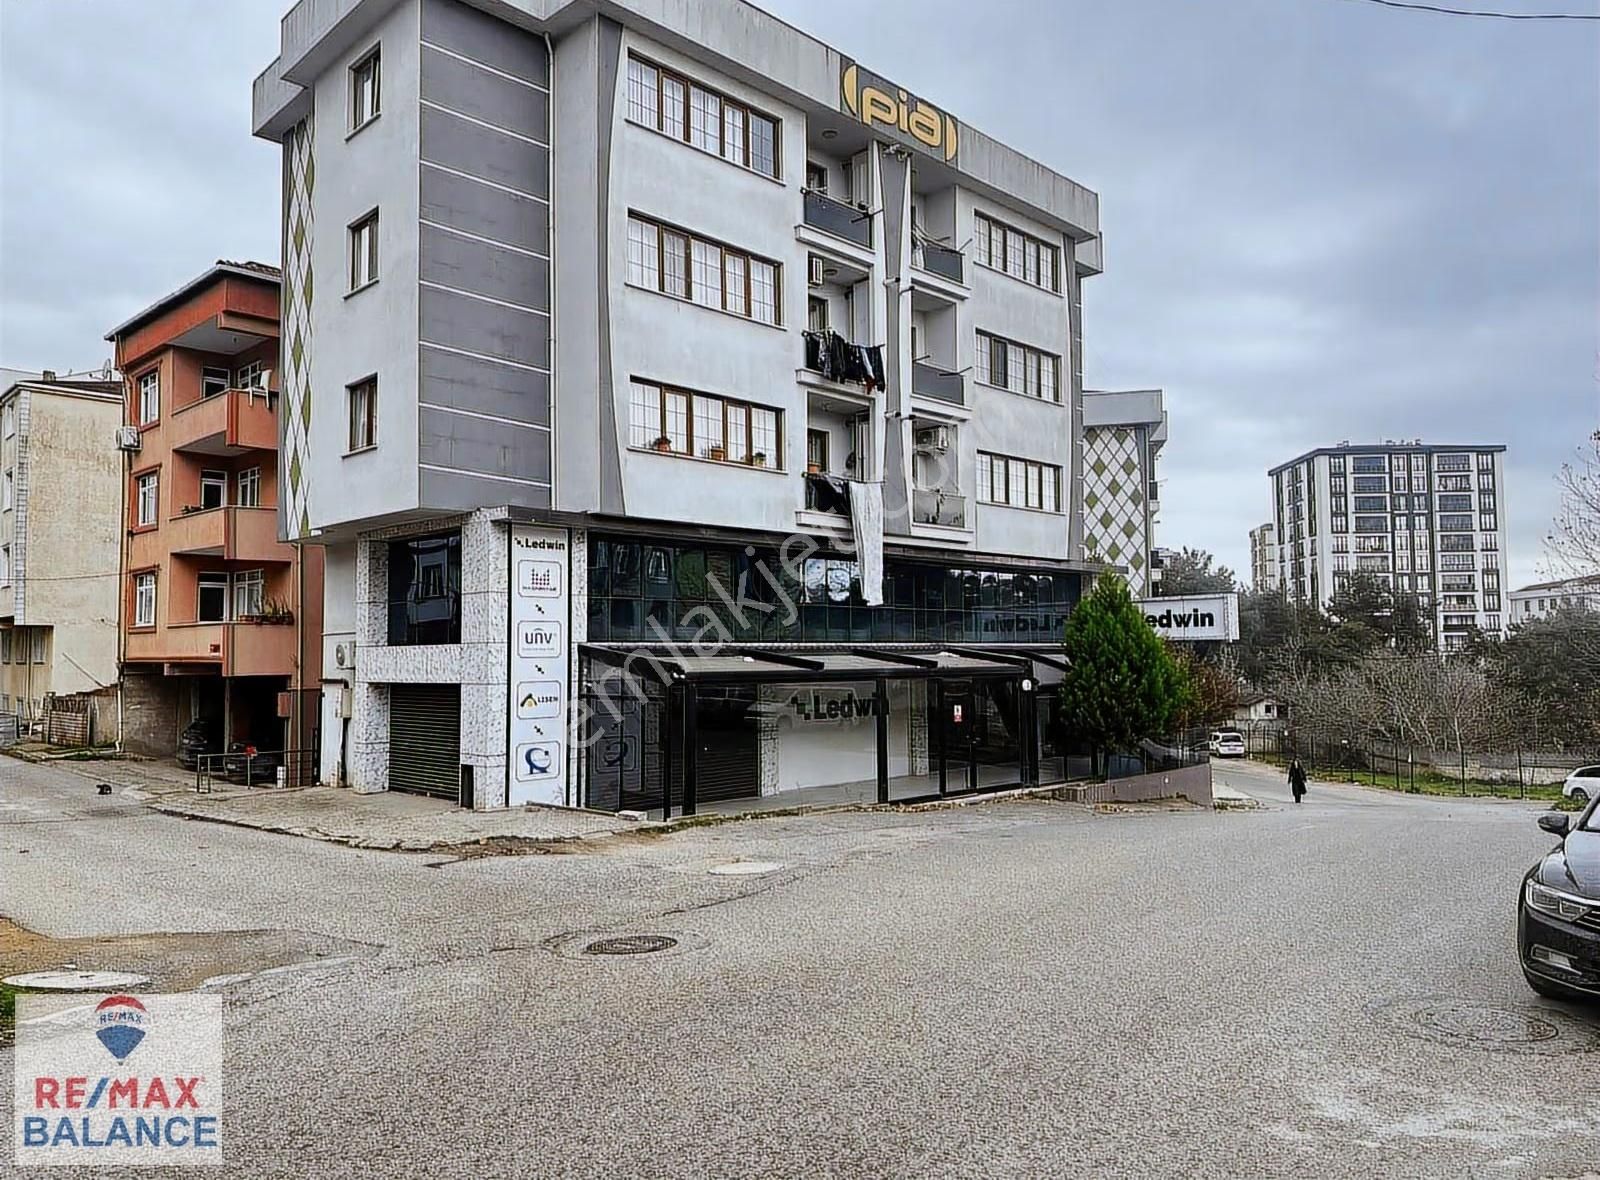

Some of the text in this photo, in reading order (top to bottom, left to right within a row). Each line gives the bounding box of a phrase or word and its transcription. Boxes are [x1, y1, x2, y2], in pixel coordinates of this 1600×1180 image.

[525, 538, 565, 550] Ledwin
[1144, 608, 1214, 629] edwin
[813, 692, 889, 719] Ledwi
